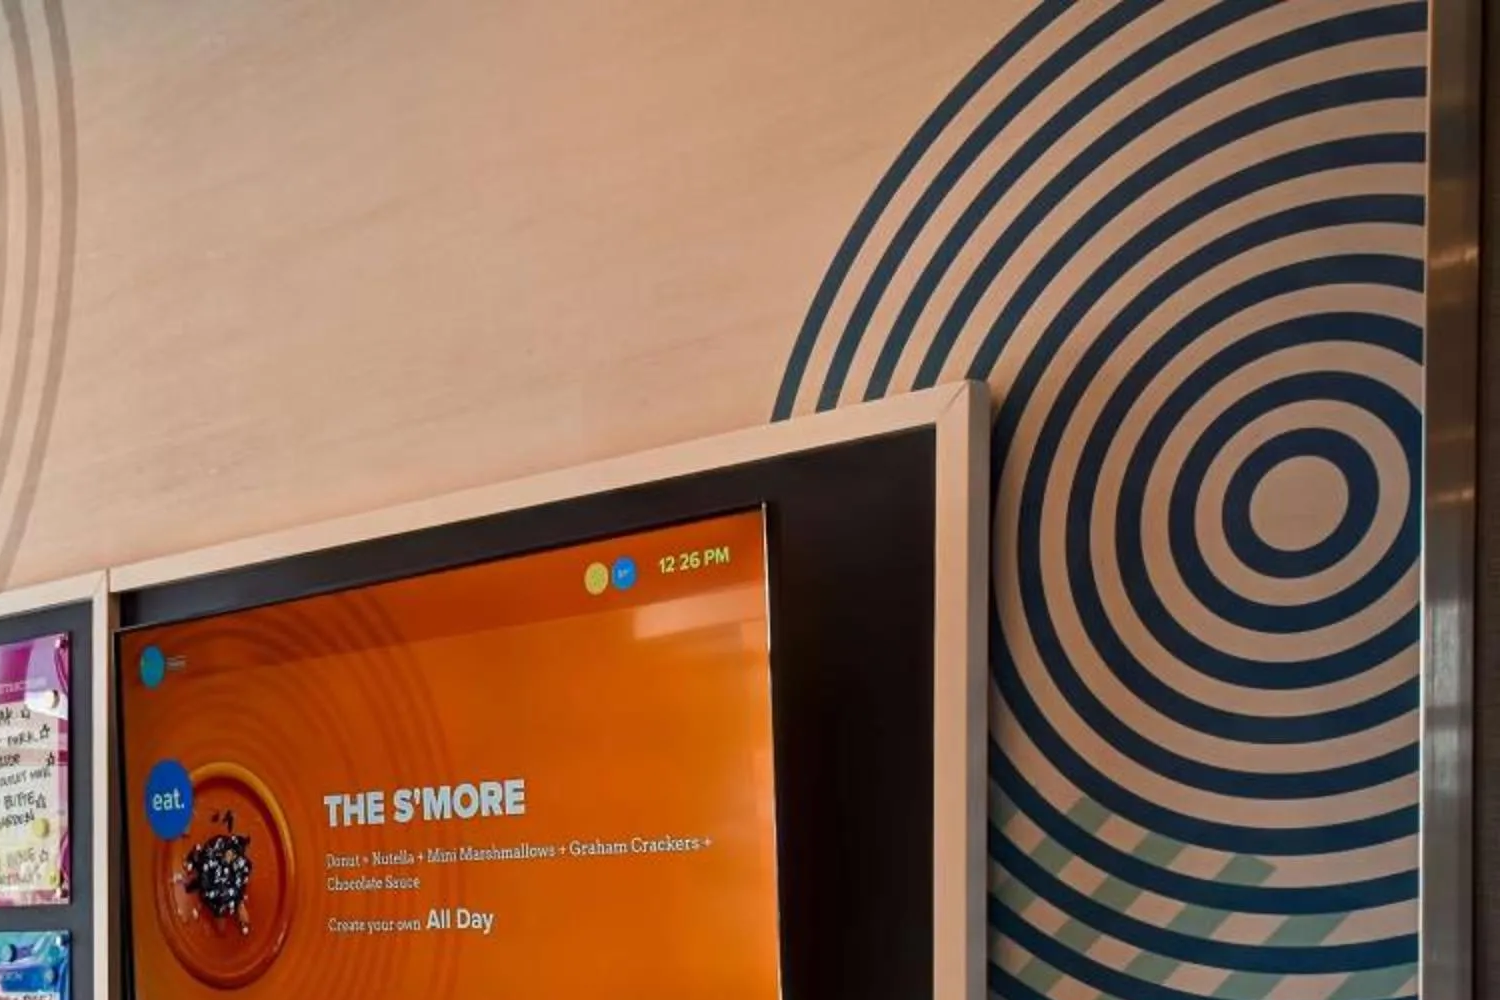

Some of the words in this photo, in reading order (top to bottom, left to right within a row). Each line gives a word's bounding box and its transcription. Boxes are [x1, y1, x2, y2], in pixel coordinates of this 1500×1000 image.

[703, 546, 730, 566] PM
[152, 787, 185, 811] eat.
[324, 791, 386, 828] THE
[393, 778, 525, 823] S'MORE
[326, 852, 360, 868] Donut
[372, 849, 415, 866] Nutella
[427, 847, 457, 864] Mini
[459, 842, 556, 863] Marshmallows
[569, 838, 628, 857] Graham
[631, 834, 700, 854] Crackers
[327, 875, 383, 891] Chocolate
[385, 874, 420, 890] Sauce
[328, 916, 366, 932] Create
[367, 919, 395, 934] your
[397, 919, 421, 931] own
[426, 907, 451, 929] All
[457, 907, 494, 935] Day
